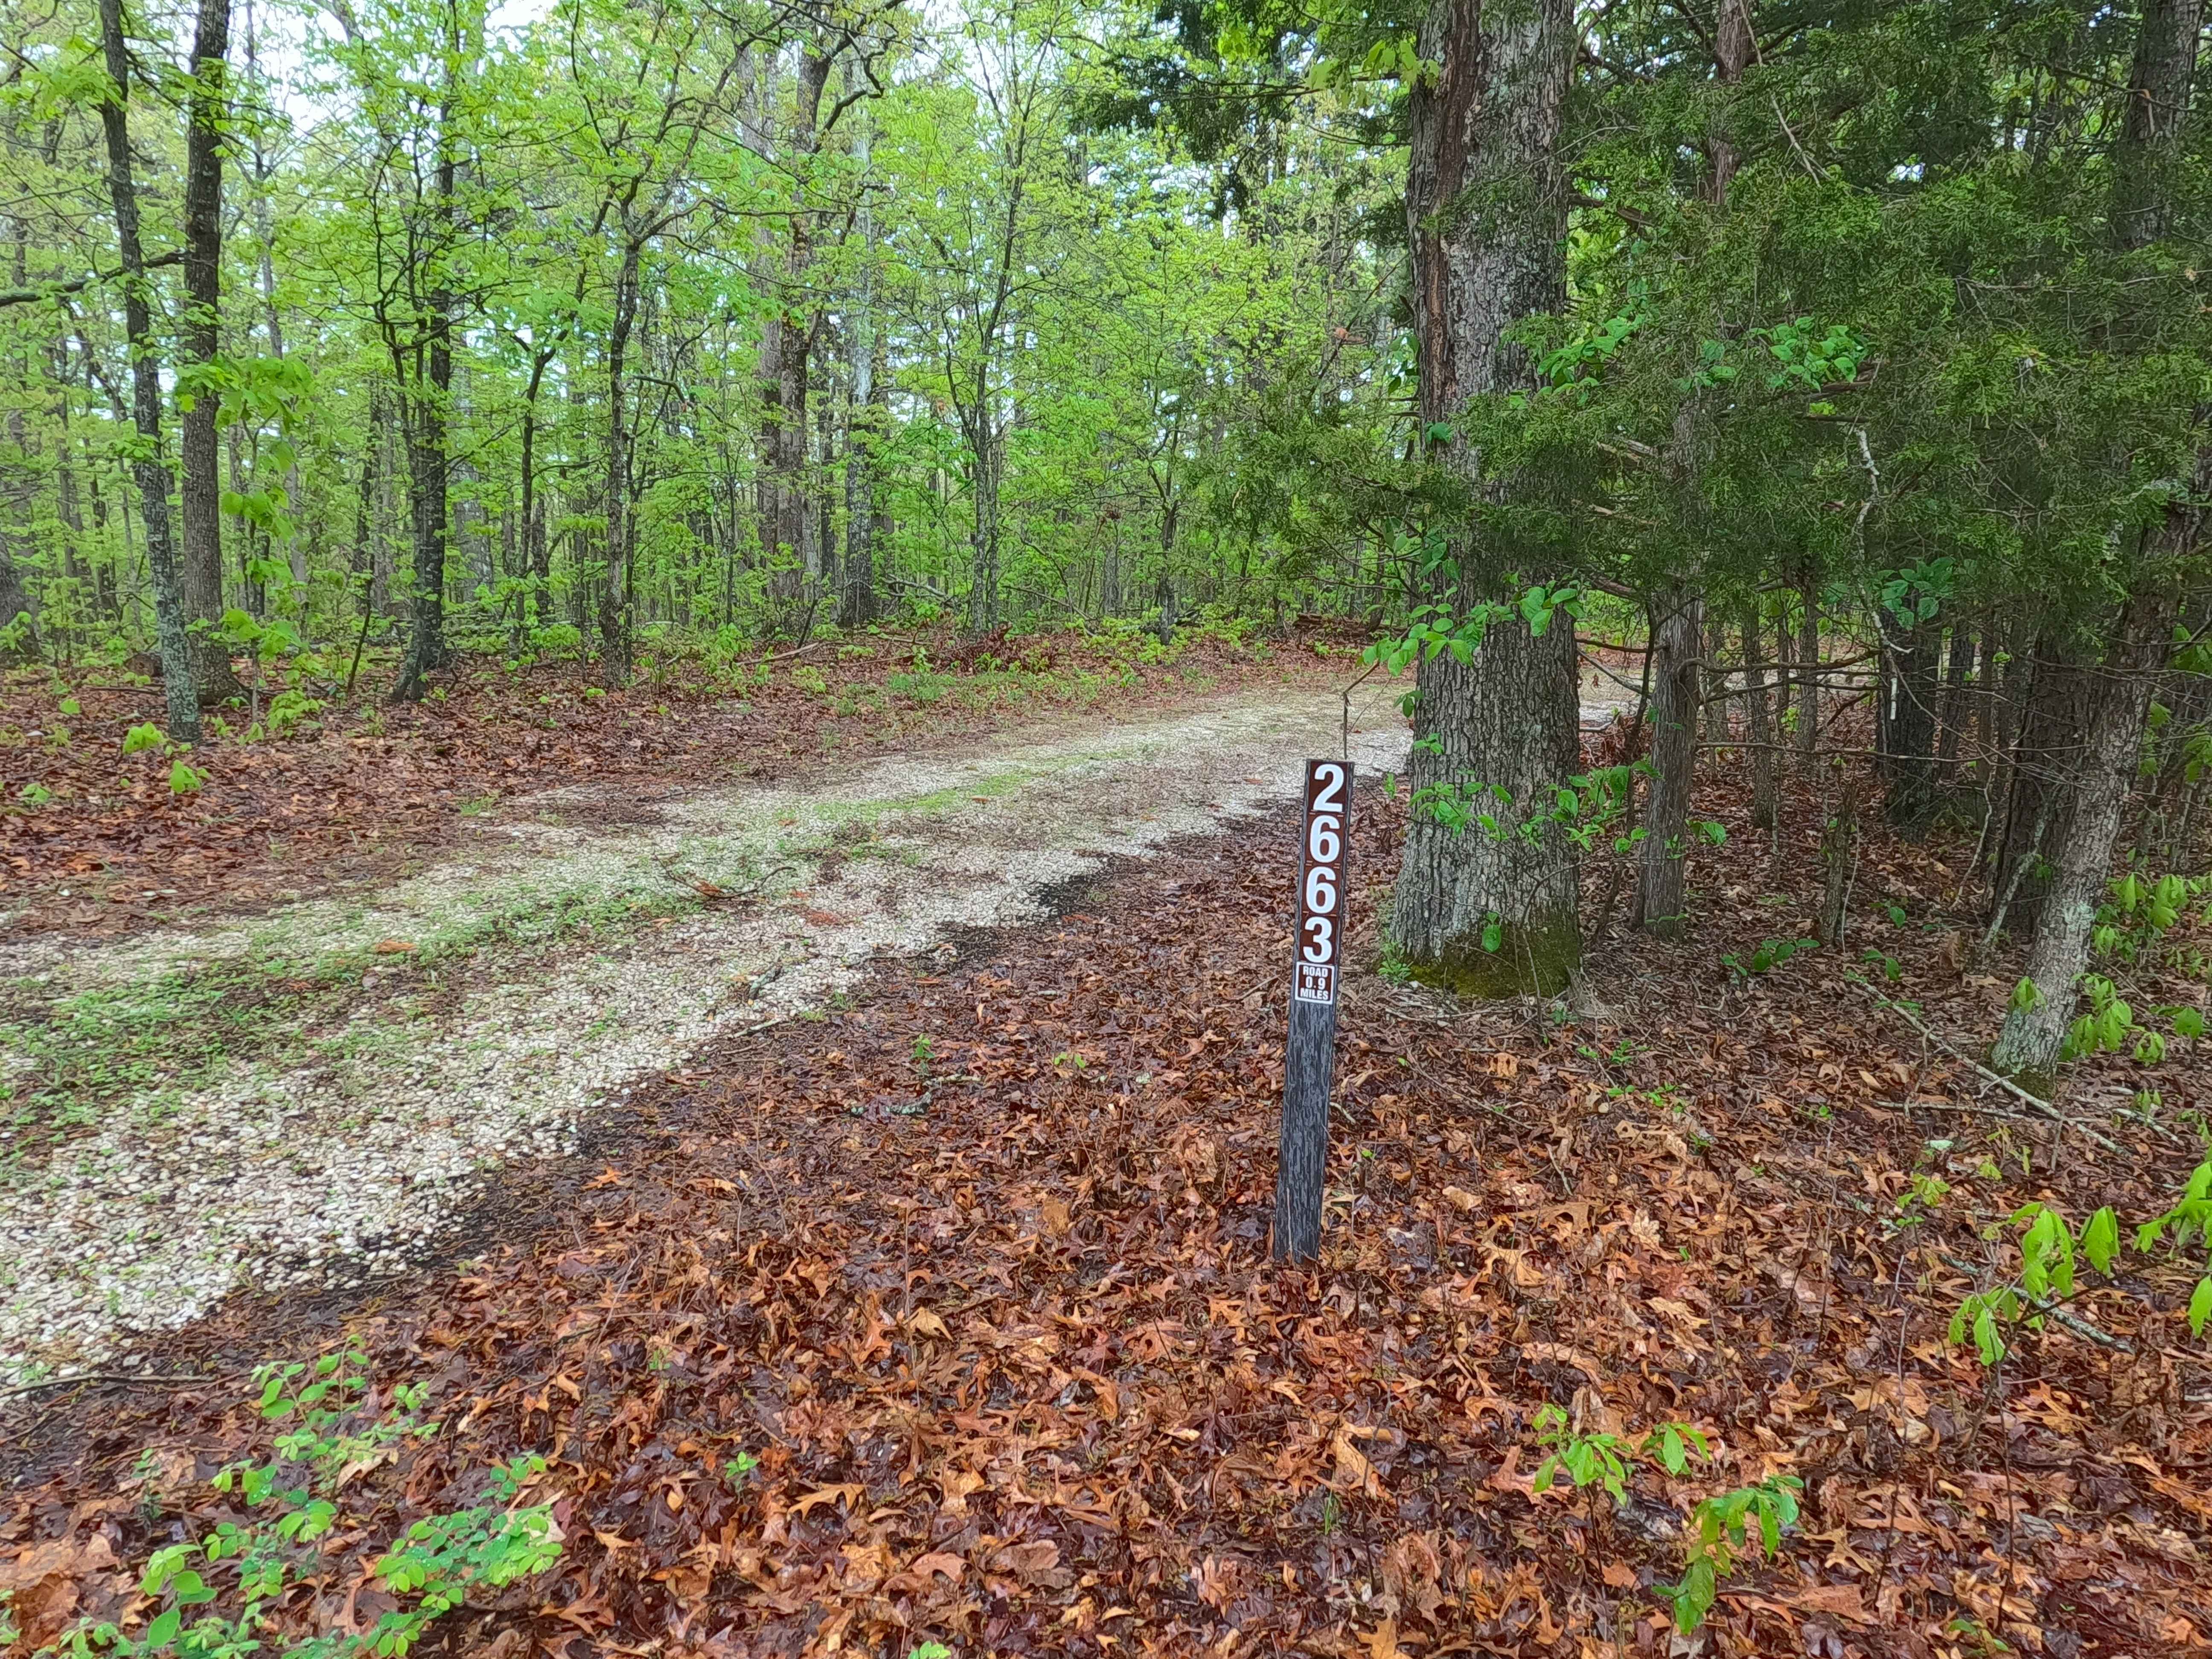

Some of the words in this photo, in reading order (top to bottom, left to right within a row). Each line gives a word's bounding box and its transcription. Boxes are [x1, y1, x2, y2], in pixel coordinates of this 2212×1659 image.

[1303, 763, 1344, 963] 2663
[1303, 966, 1328, 978] ROAD
[1306, 976, 1326, 990] 0.9
[1300, 987, 1329, 1000] MILES
